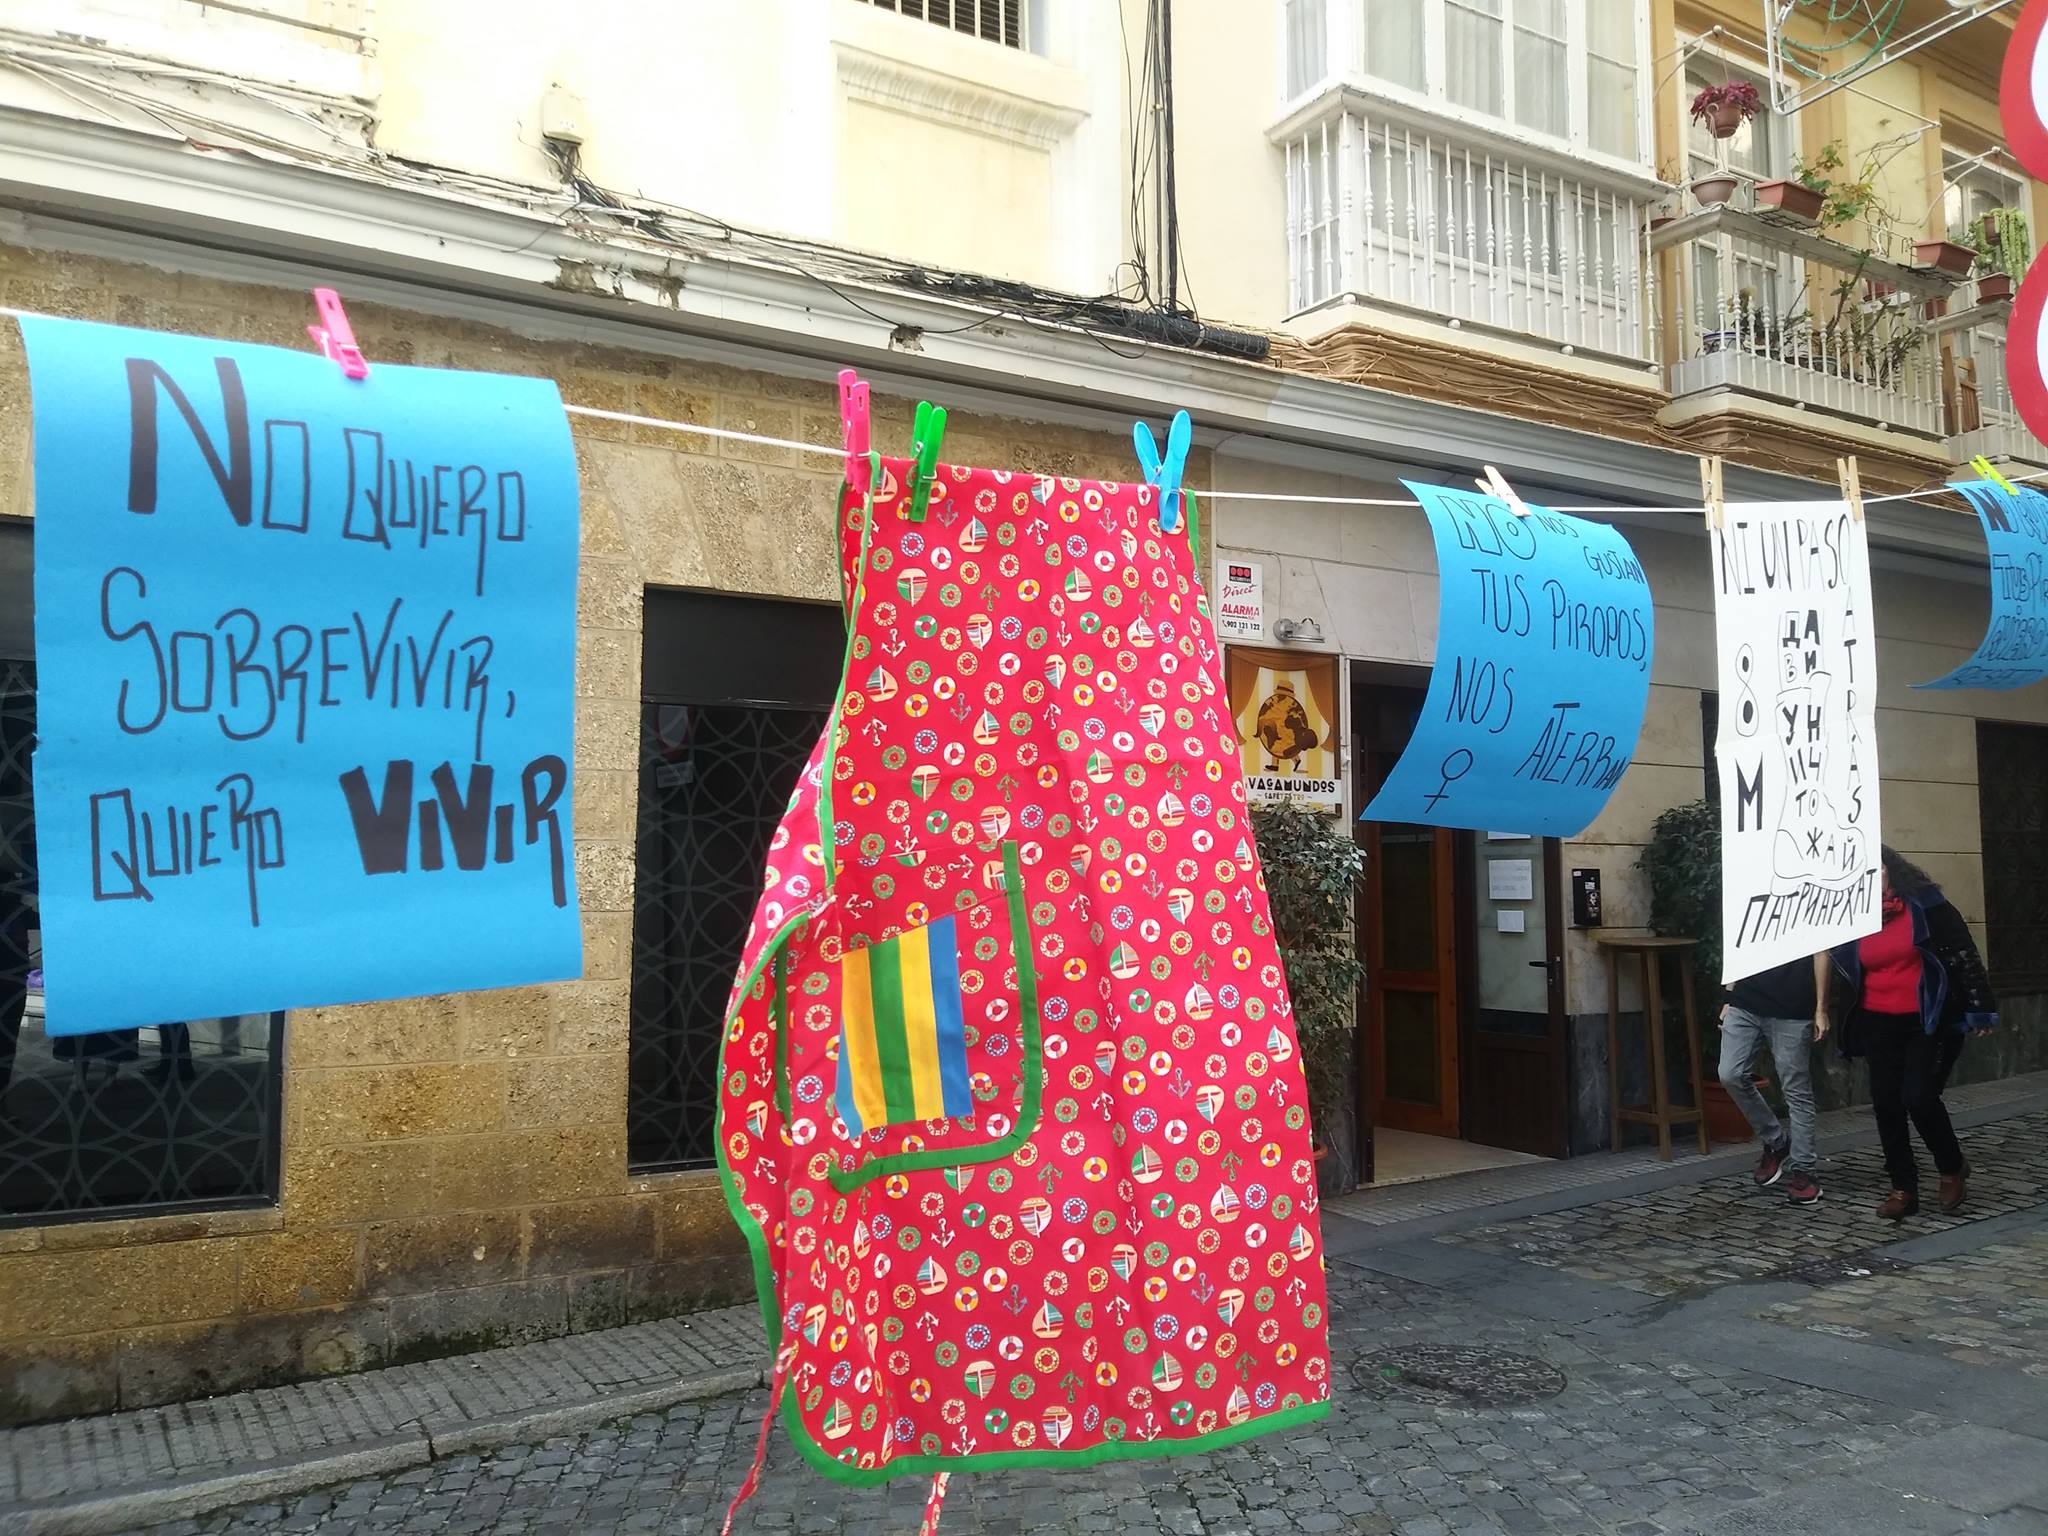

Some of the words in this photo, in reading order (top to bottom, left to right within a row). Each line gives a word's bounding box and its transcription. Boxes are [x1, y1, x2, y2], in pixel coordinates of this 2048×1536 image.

[125, 356, 310, 533] NO
[343, 428, 525, 595] QUIERO
[1436, 495, 1536, 560] NO
[1534, 513, 1579, 538] NOS
[1719, 522, 1755, 595] NI
[1761, 520, 1792, 592] UN
[1797, 513, 1850, 592] PASO
[1222, 583, 1257, 599] Direct
[1583, 545, 1646, 584] GUSTAN
[1221, 603, 1260, 617] ALARMA
[1226, 620, 1237, 629] 902
[1238, 621, 1249, 630] 121
[1250, 622, 1260, 631] 122
[1471, 568, 1530, 637] TUS
[100, 566, 516, 761] SOBREVIVIR,
[1446, 656, 1514, 734] NOS
[1513, 702, 1628, 790] ATERRAN
[90, 772, 285, 926] QUIERO
